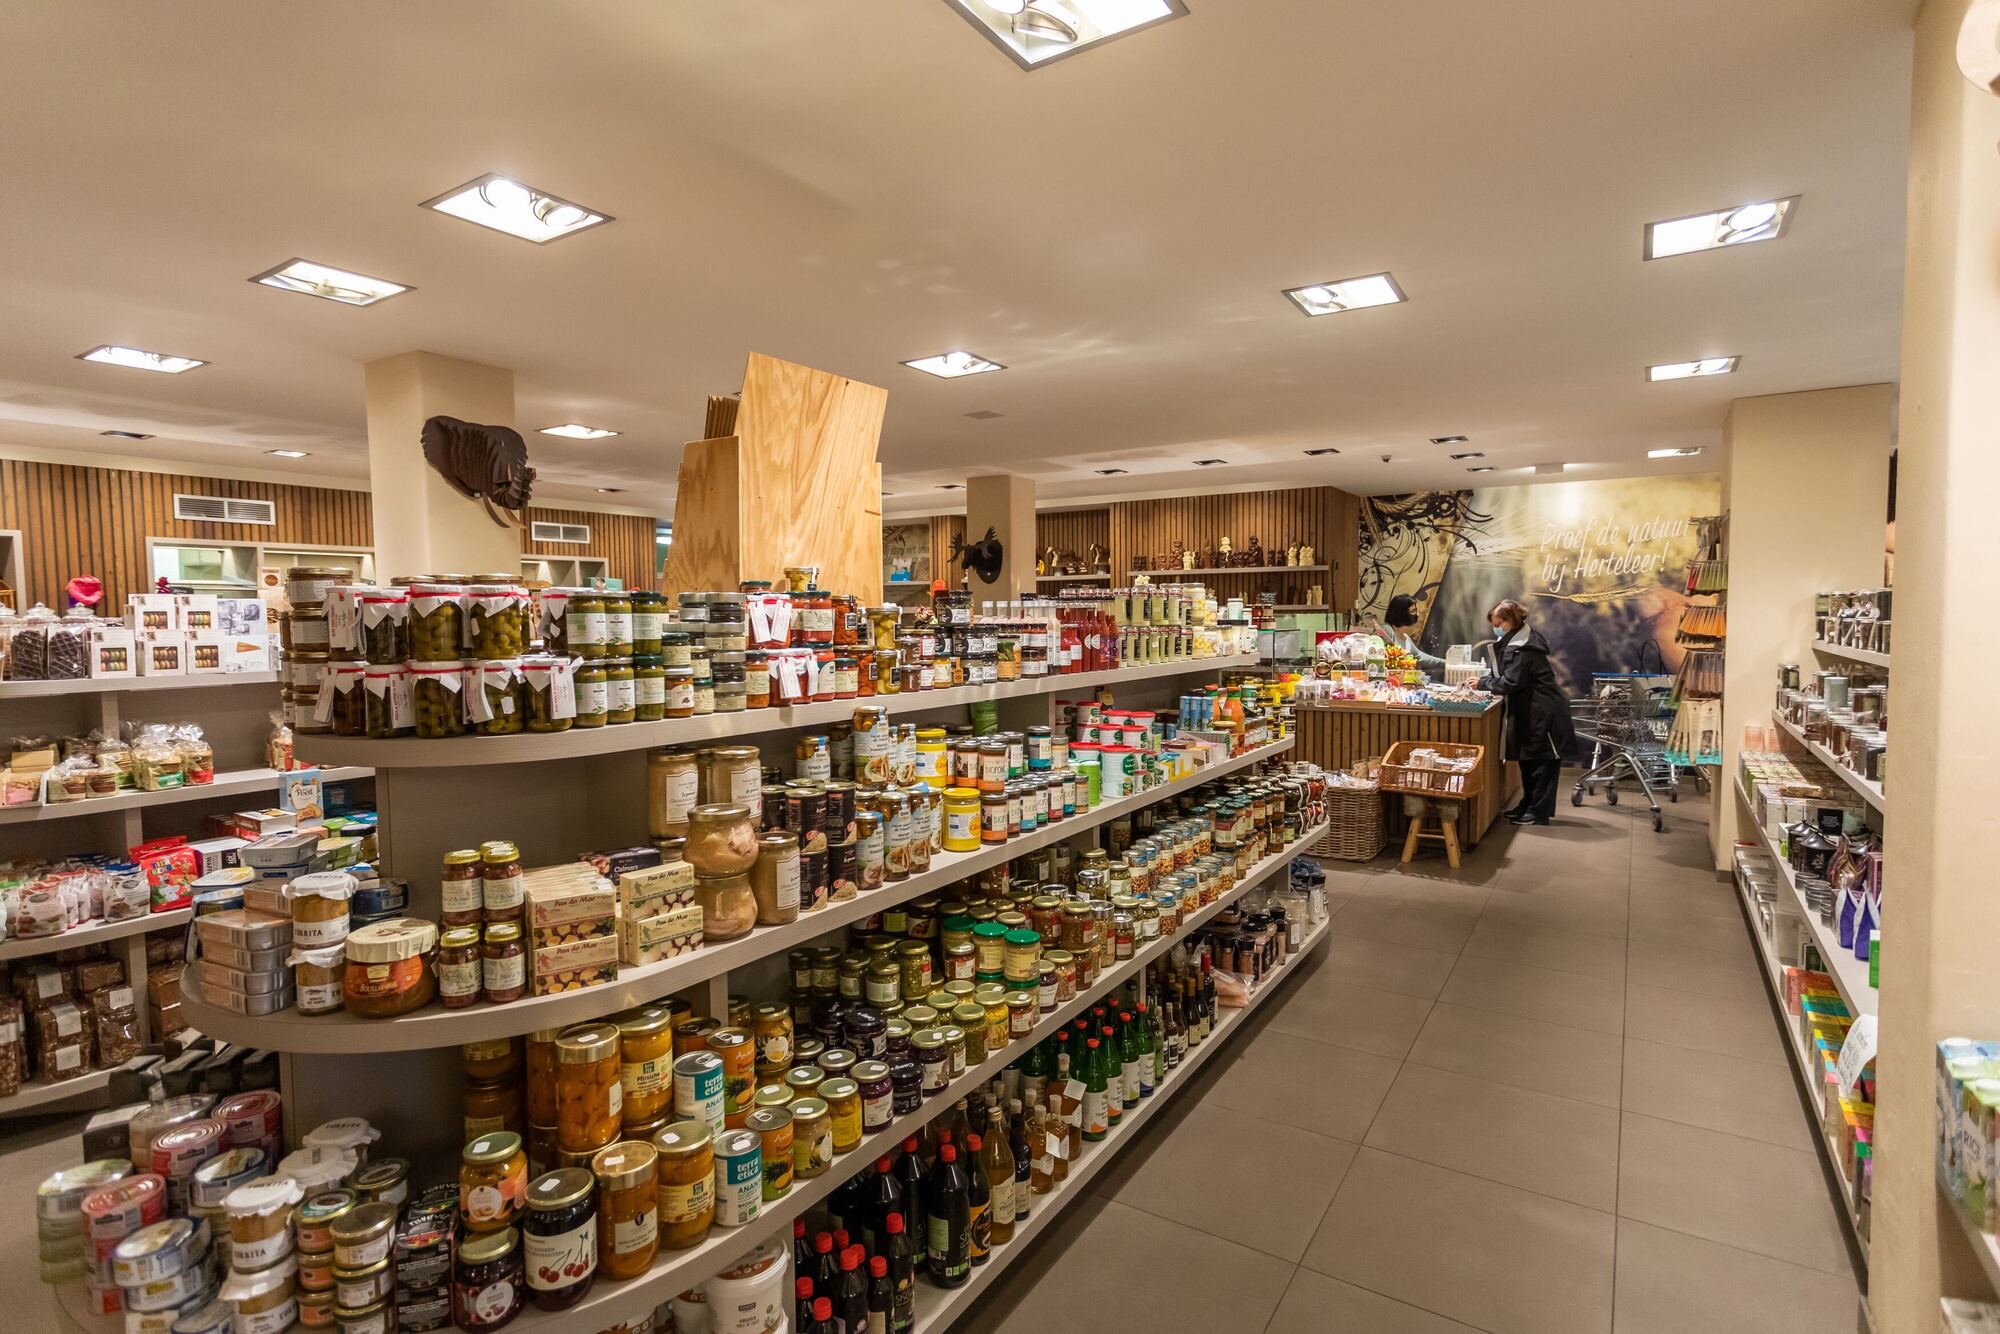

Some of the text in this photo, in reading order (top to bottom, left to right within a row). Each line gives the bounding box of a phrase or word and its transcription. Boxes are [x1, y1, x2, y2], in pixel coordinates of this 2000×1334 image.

[1540, 515, 1690, 552] Proef de natuur
[1542, 541, 1670, 593] bij Herteleer!
[704, 1073, 723, 1087] terra
[704, 1081, 723, 1096] etica
[737, 1157, 759, 1173] terra
[737, 1165, 759, 1180] etica
